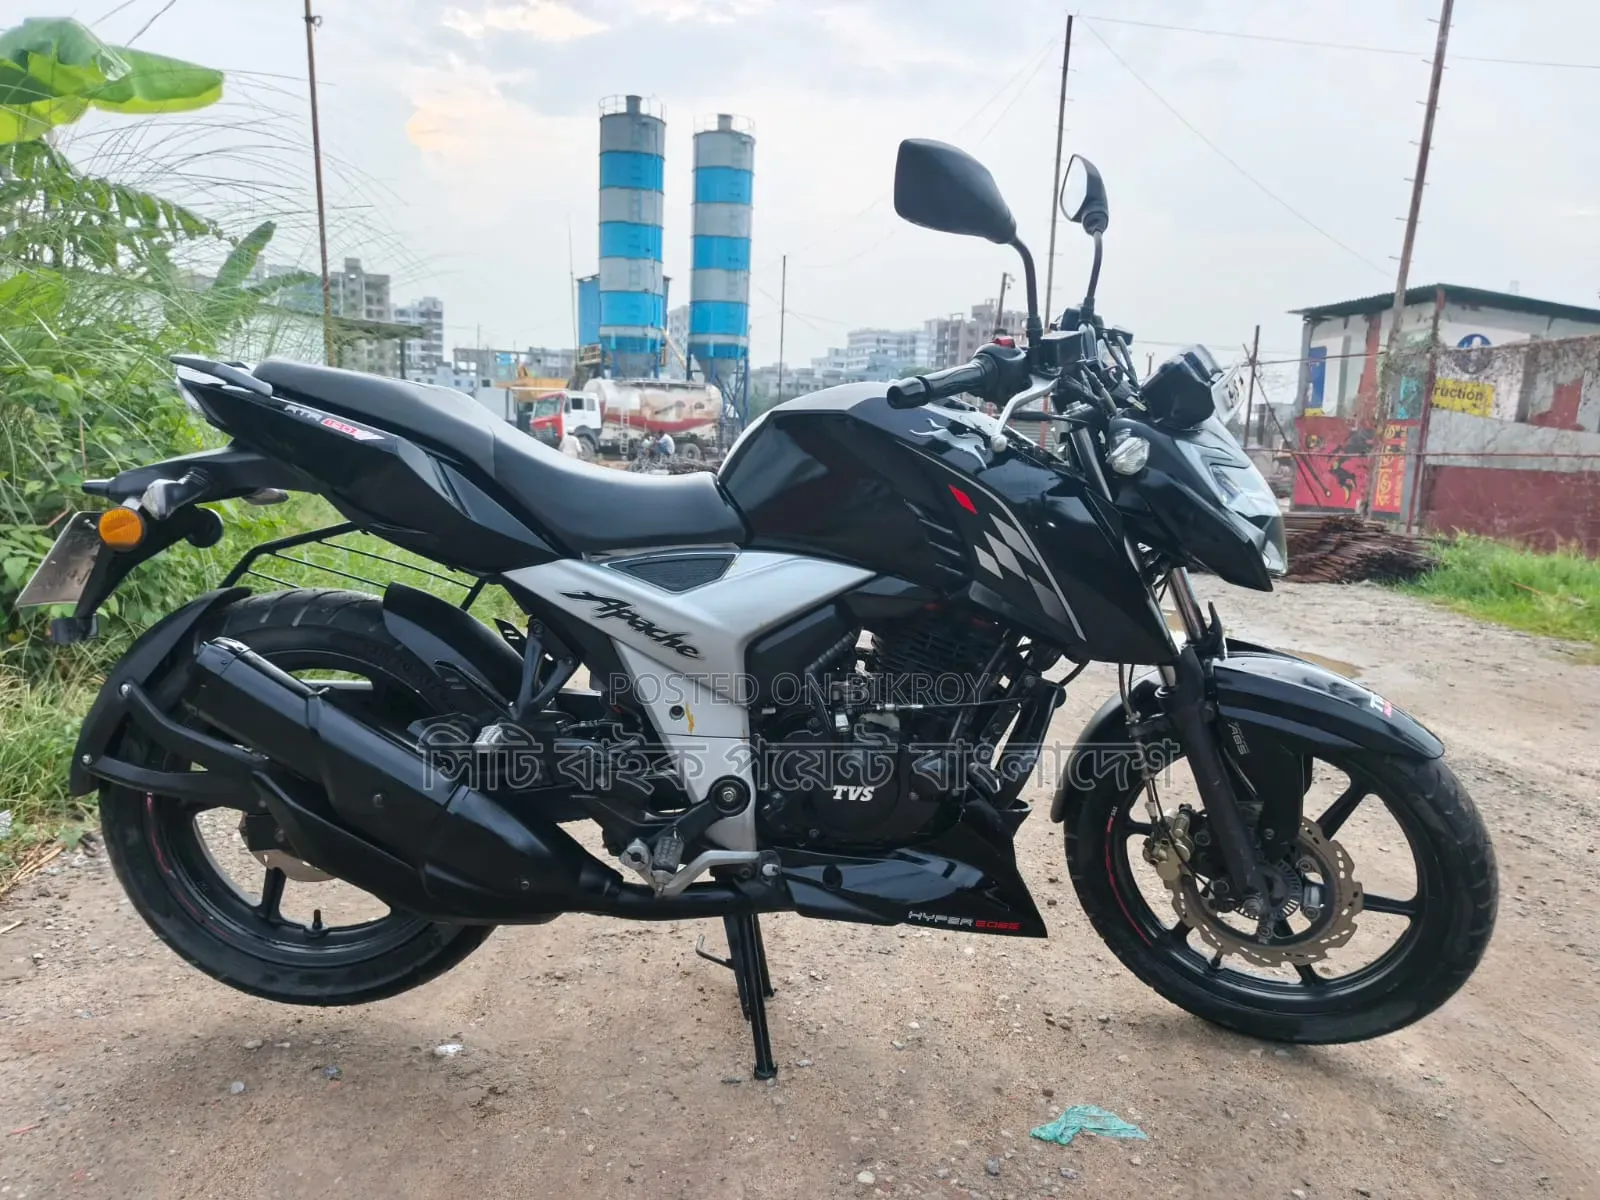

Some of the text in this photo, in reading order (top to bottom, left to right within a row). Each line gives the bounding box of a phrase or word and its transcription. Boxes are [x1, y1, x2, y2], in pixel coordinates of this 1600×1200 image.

[560, 590, 703, 661] Apache
[832, 785, 875, 801] TVS
[908, 910, 973, 927] HYPER
